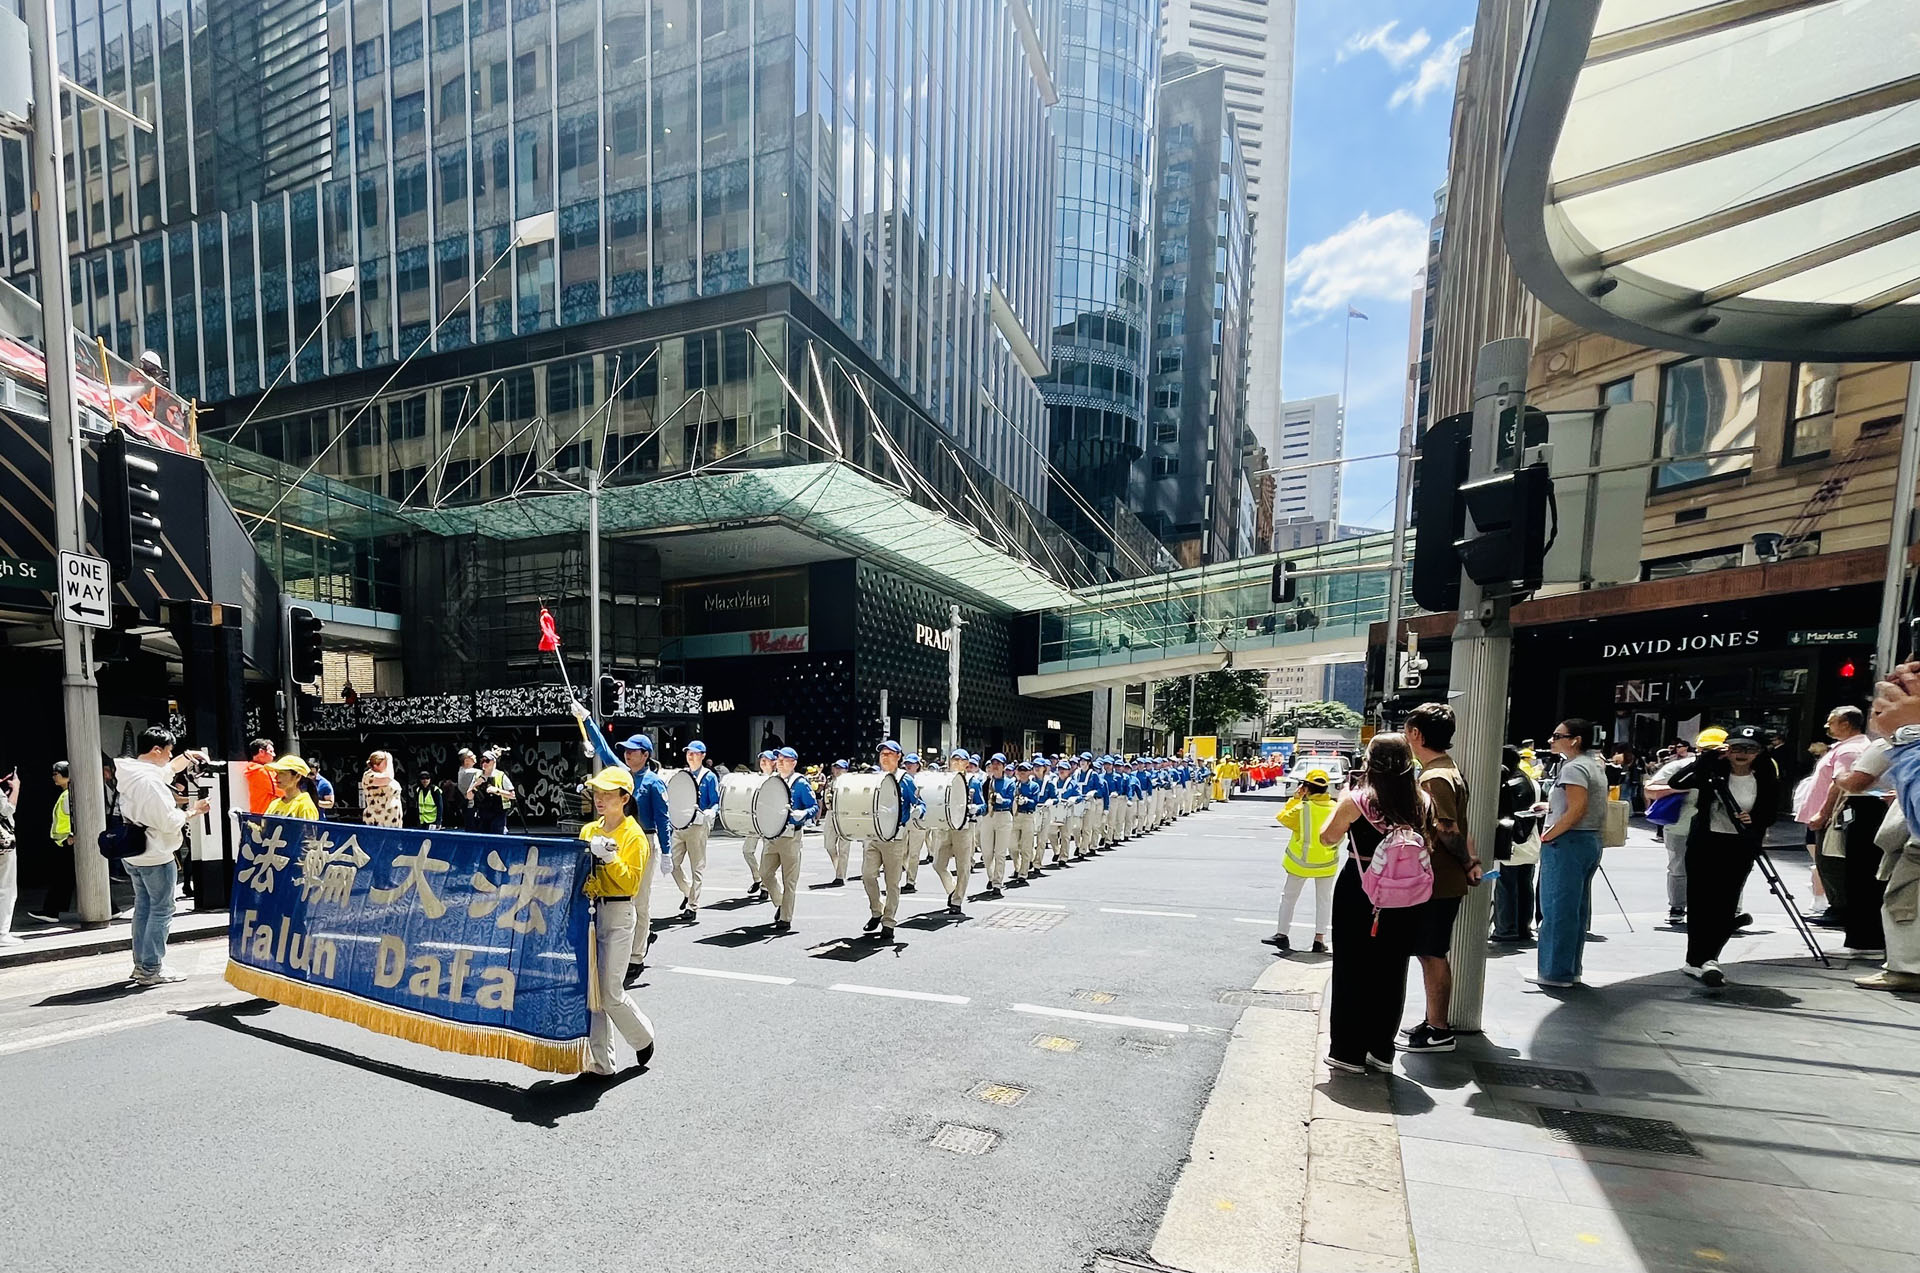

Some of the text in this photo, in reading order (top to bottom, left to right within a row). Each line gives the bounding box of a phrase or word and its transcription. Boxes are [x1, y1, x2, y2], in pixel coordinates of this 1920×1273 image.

[19, 562, 37, 578] St
[69, 560, 102, 581] ONE
[67, 580, 104, 601] WAY
[749, 630, 808, 653] Westfield
[916, 623, 951, 652] PRAD
[1603, 630, 1760, 658] DAVID JONES
[1807, 630, 1858, 641] Market St
[707, 698, 735, 713] PRADA
[238, 823, 565, 936] 法輪大法
[241, 909, 517, 1012] Falun Dafa
